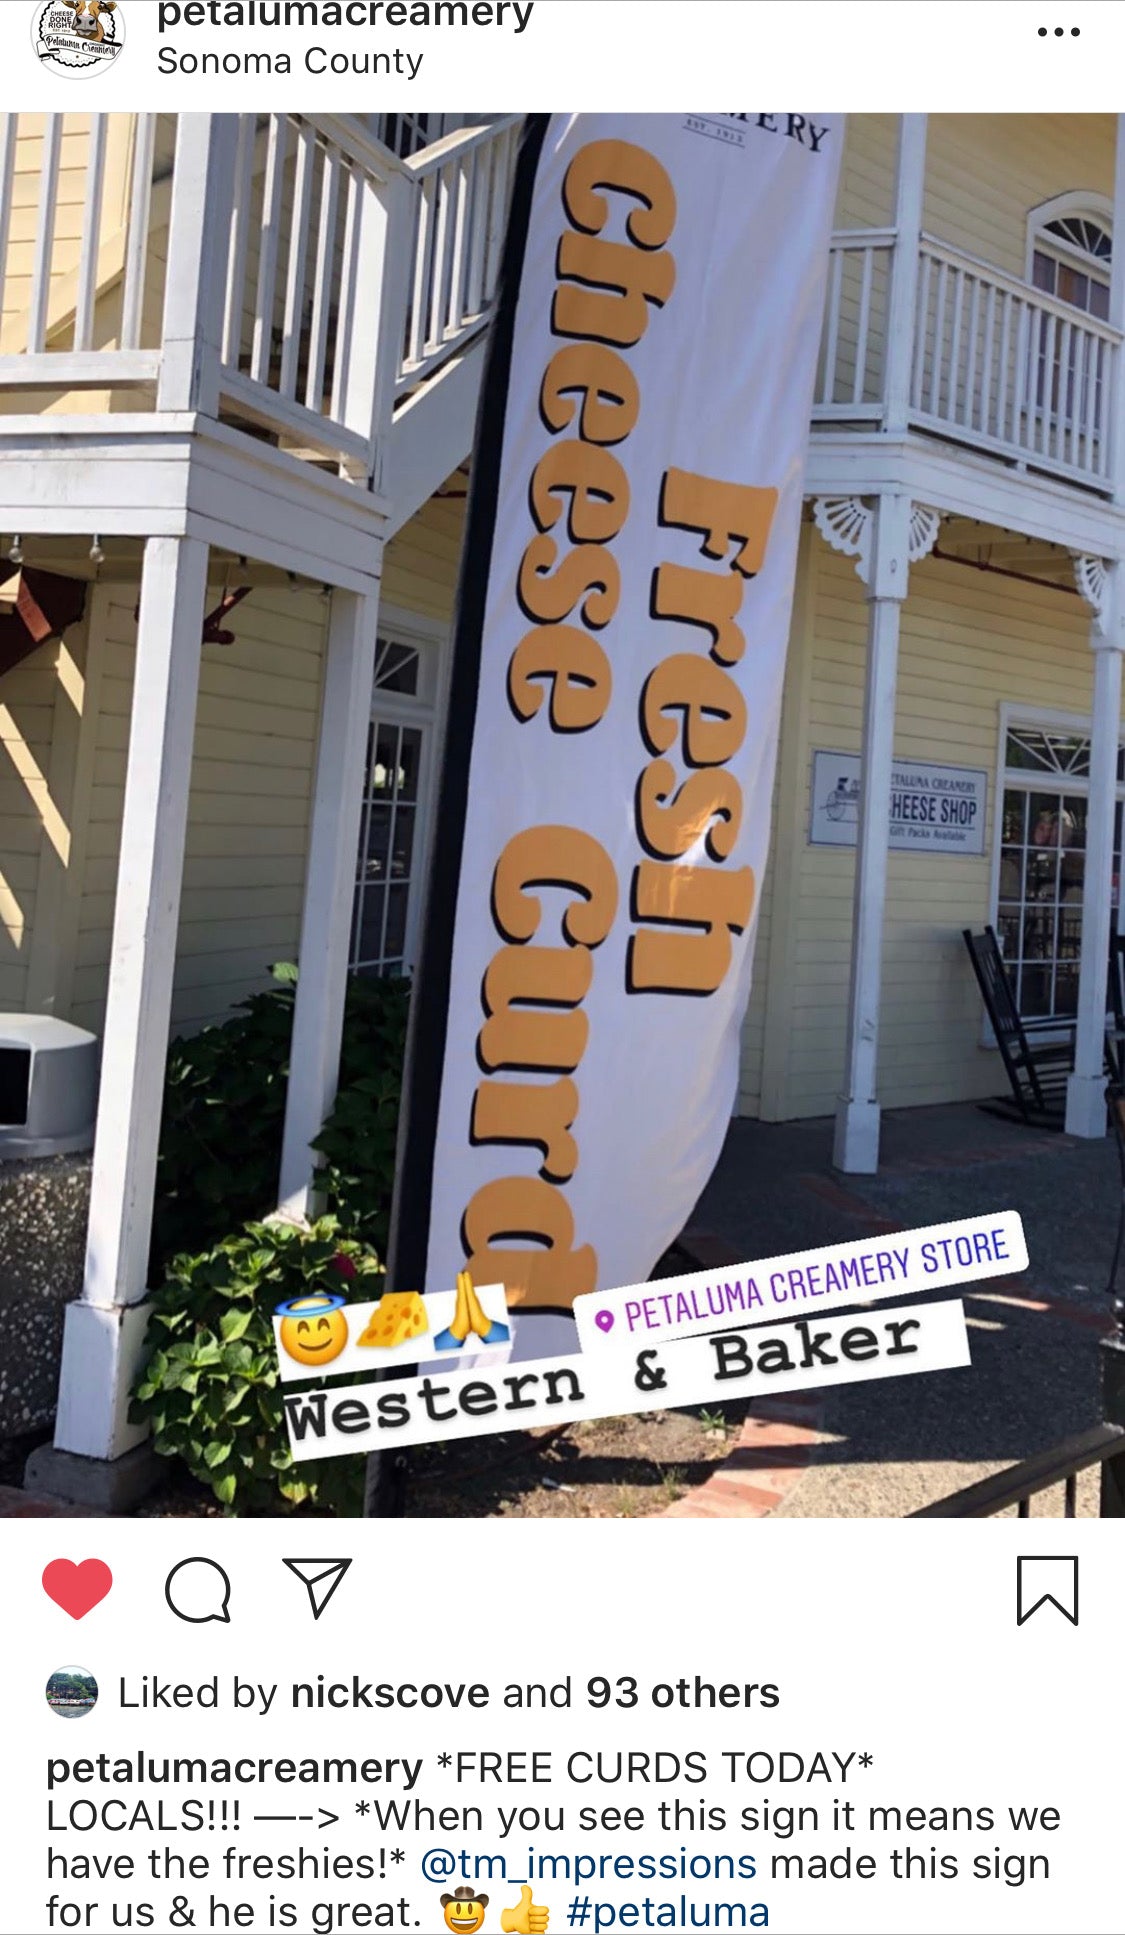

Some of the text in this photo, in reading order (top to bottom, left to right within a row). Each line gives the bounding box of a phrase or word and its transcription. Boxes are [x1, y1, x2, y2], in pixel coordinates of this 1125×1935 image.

[460, 139, 677, 1319] Cheese Curd
[626, 465, 778, 997] Fresh
[889, 793, 977, 825] HEESE SHOP
